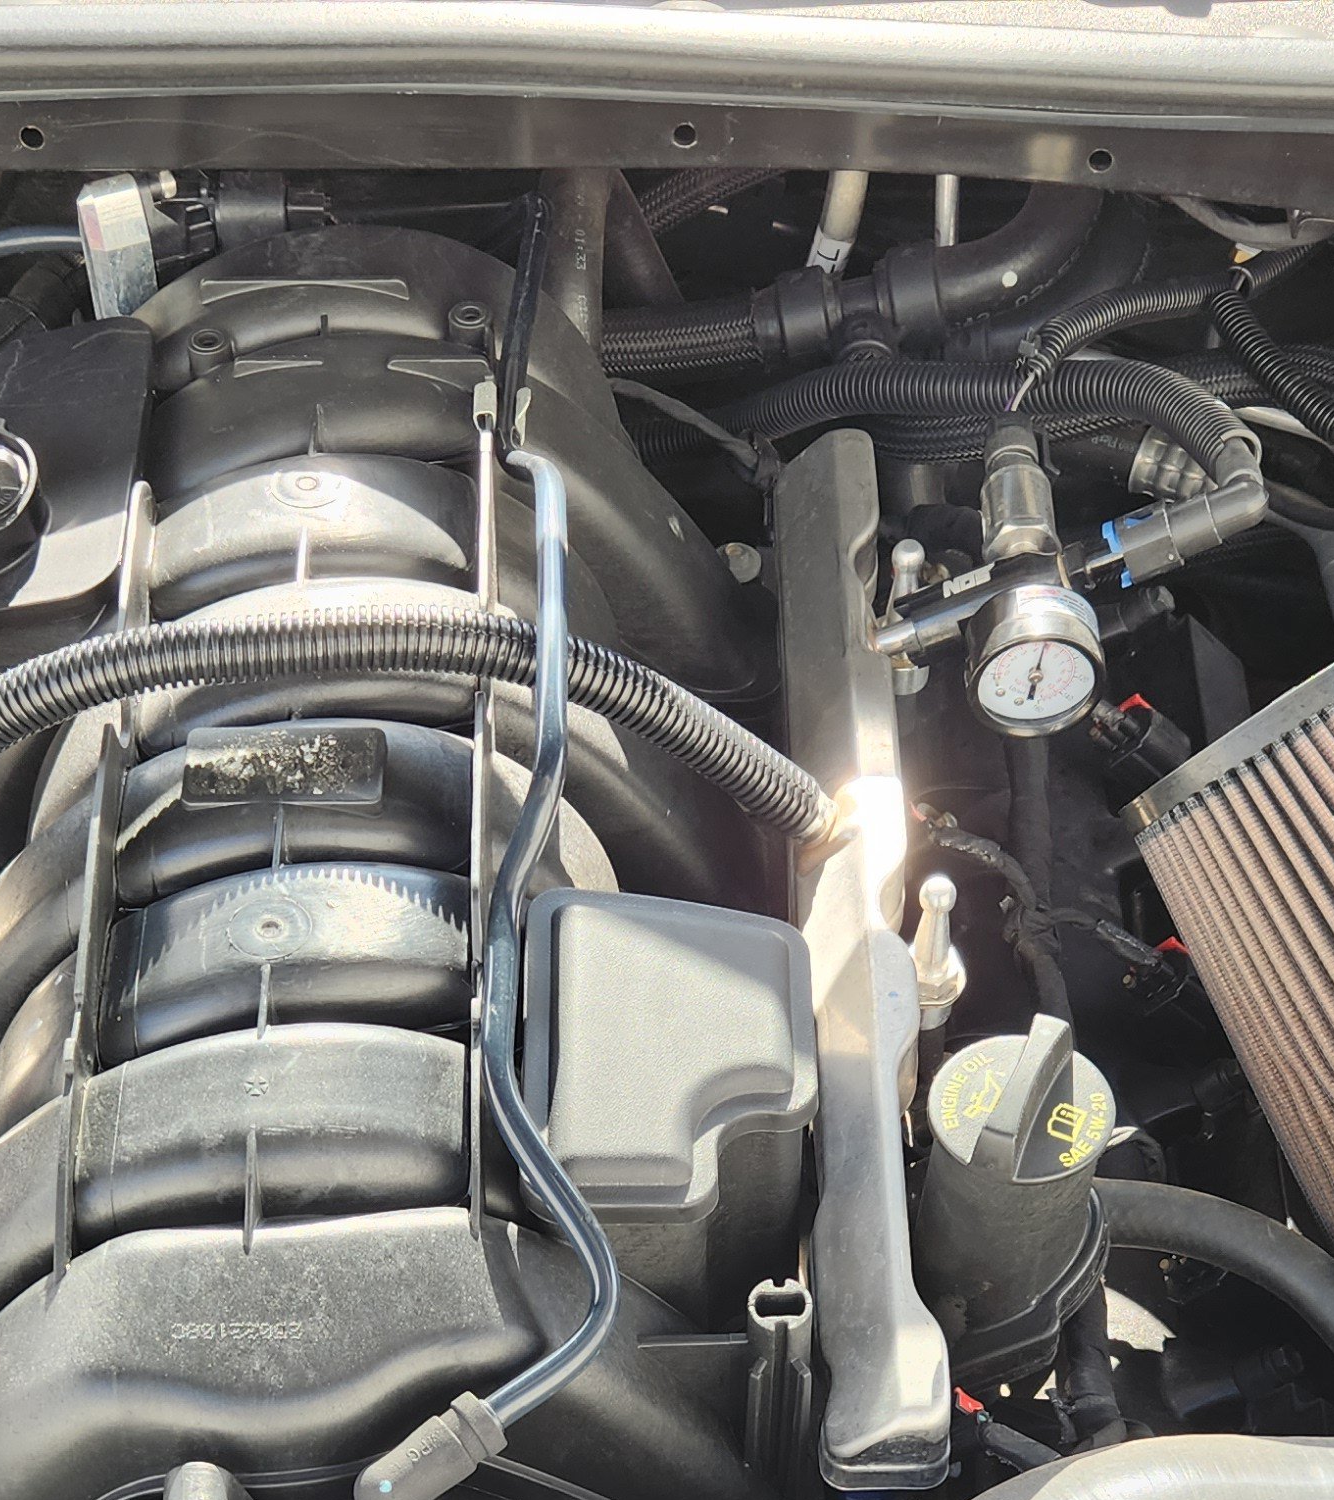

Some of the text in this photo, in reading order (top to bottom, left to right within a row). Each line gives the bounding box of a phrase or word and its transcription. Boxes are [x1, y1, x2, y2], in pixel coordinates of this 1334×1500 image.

[940, 1051, 995, 1131] ENGINE OIL
[1058, 1092, 1109, 1168] SAE 5W-20
